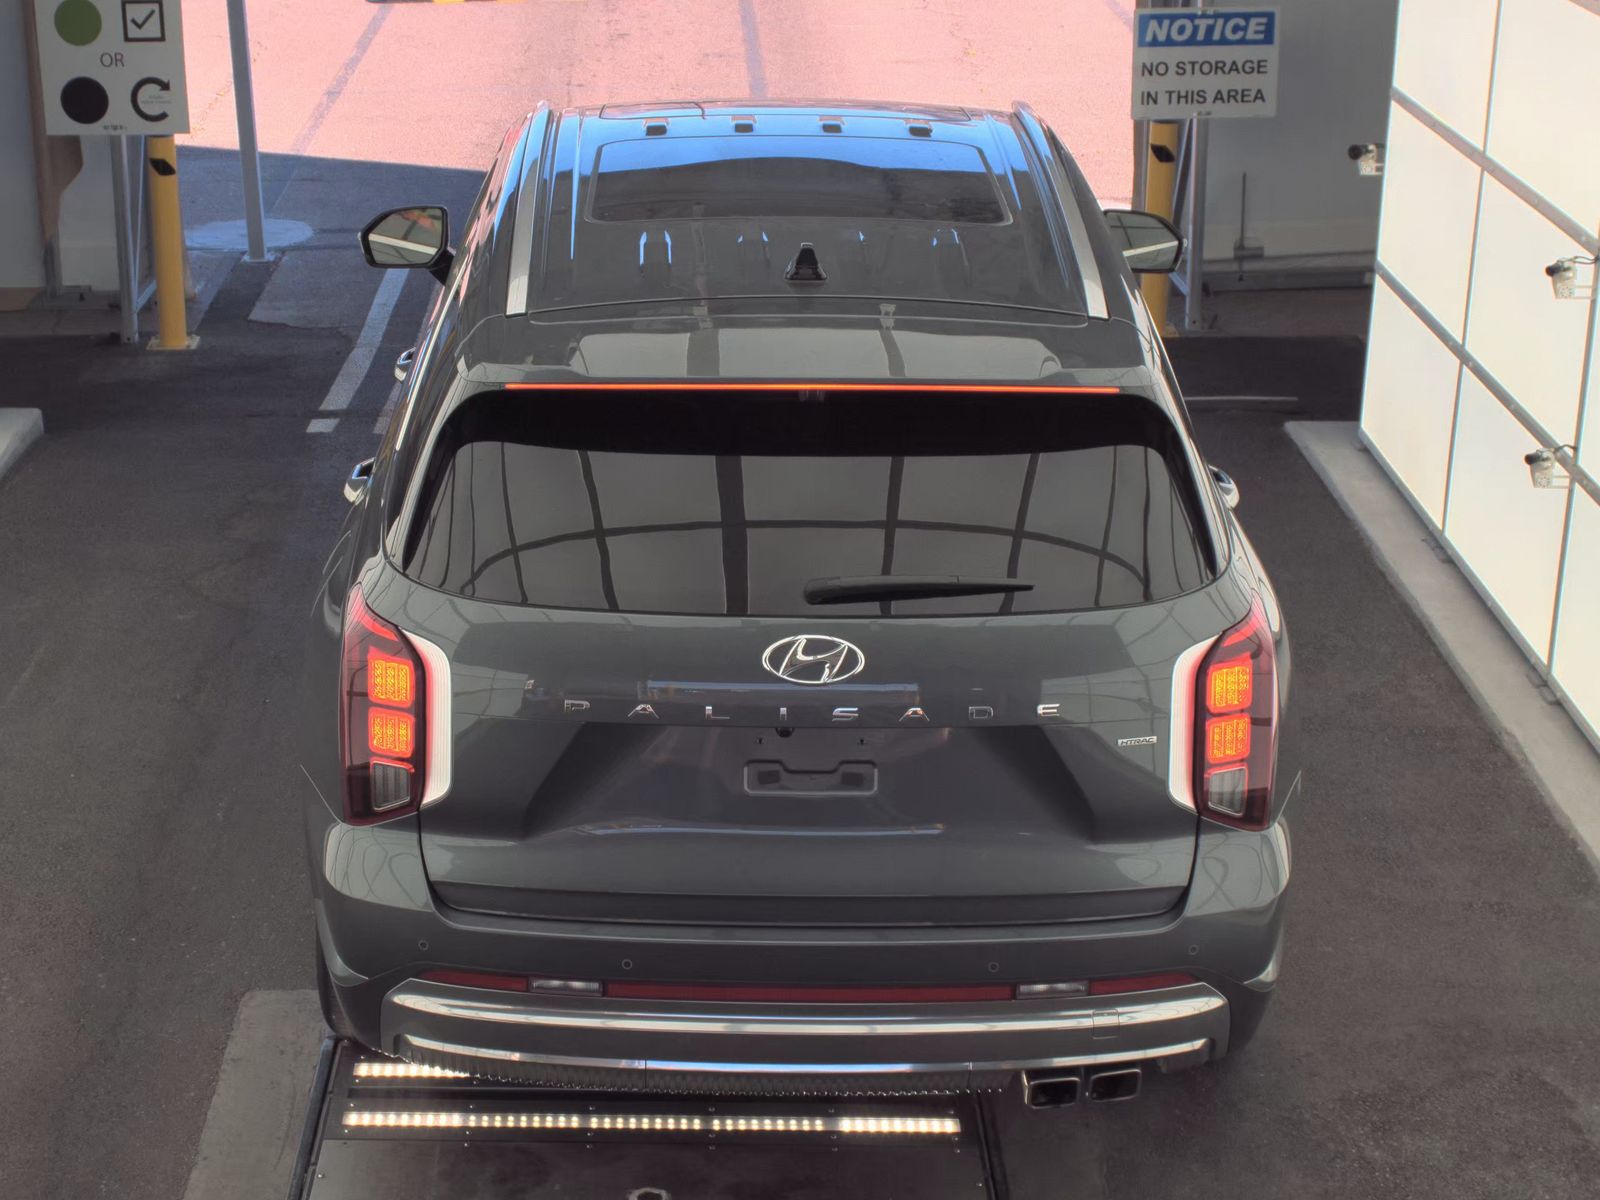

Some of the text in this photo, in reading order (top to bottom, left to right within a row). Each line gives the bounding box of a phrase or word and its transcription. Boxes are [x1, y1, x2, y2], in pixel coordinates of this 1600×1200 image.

[1145, 16, 1268, 42] NOTICE
[100, 52, 125, 68] OR
[1141, 59, 1268, 77] NO STORAGE
[1140, 88, 1266, 106] IN THIS AREA
[564, 699, 1061, 723] PALISADE
[1119, 736, 1156, 746] HTRAC
